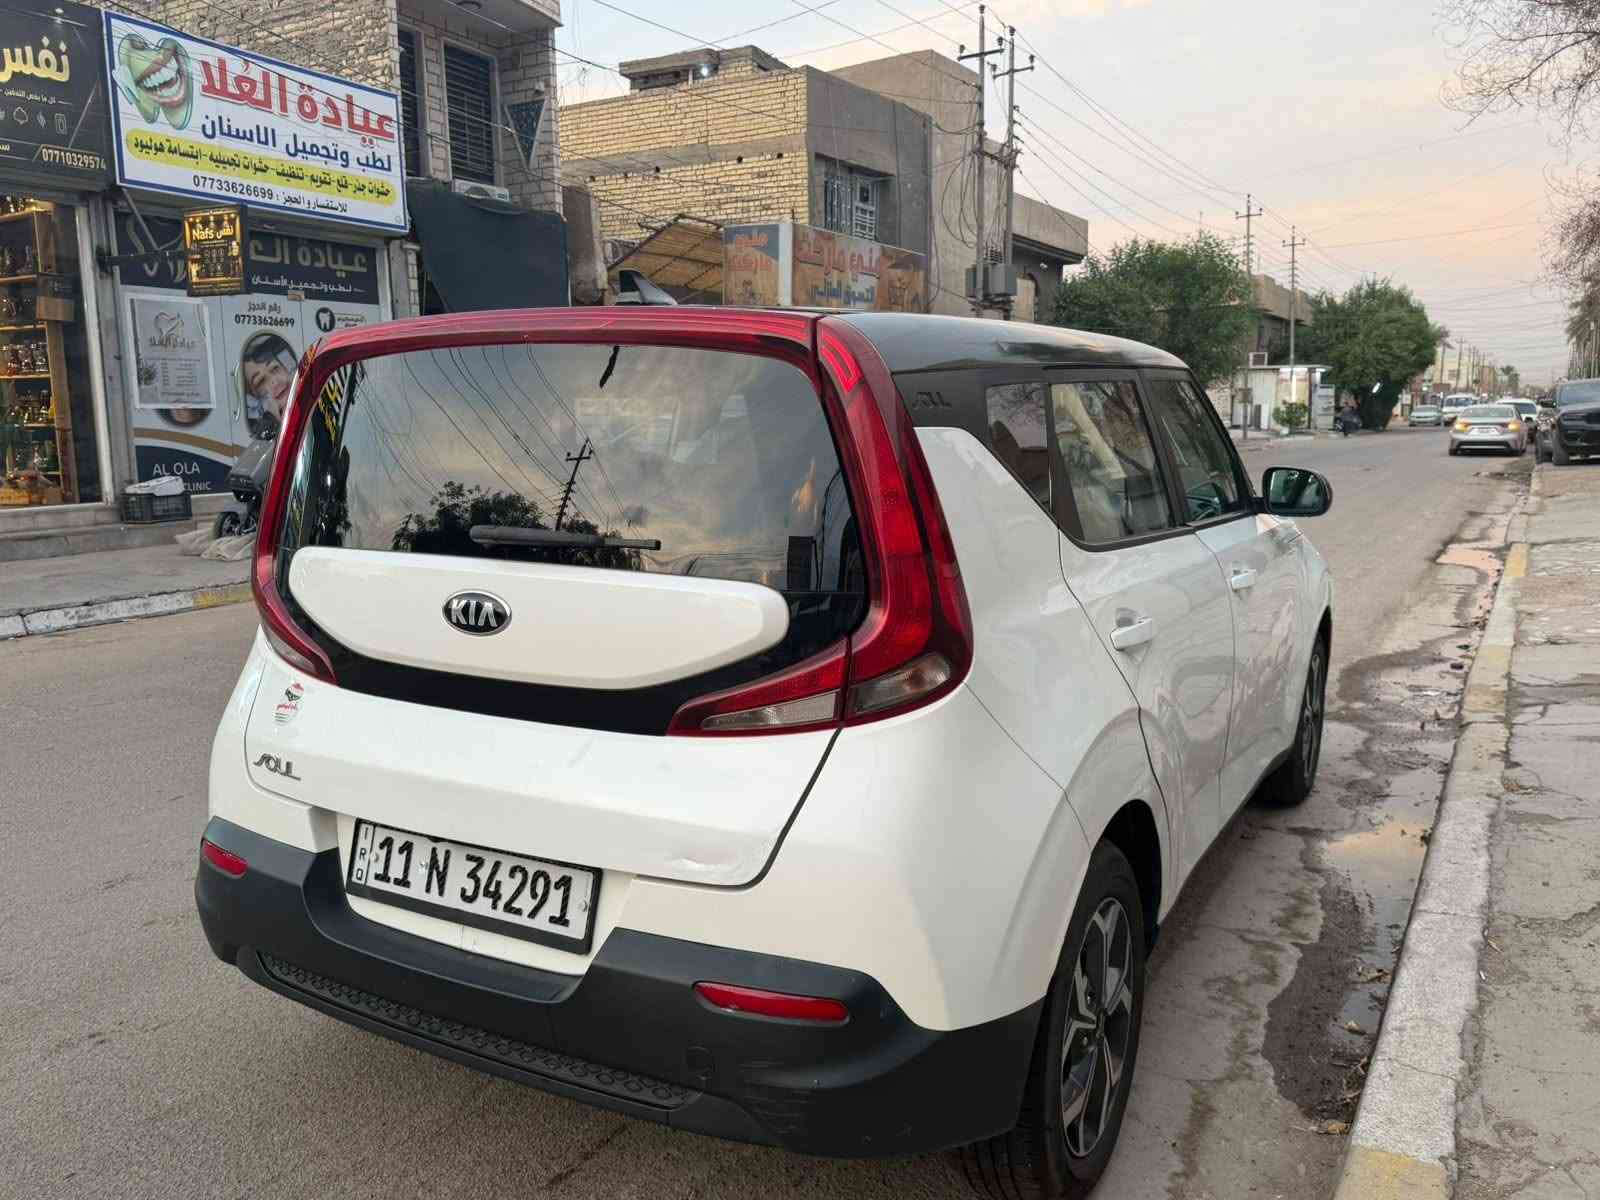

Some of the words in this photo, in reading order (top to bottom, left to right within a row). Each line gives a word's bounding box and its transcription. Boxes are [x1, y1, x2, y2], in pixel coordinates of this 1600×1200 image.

[0, 36, 70, 82] نفس
[297, 84, 395, 148] عيادة
[285, 133, 350, 169] وتجميل
[356, 151, 392, 173] لطب
[192, 174, 273, 201] 07733626699
[192, 228, 213, 240] Nafs
[152, 462, 172, 476] AL
[173, 461, 200, 475] OLA
[450, 599, 498, 628] KIA
[252, 753, 302, 781] SOUL
[374, 836, 414, 888] 11
[425, 846, 452, 897] N
[459, 853, 573, 928] 34291
